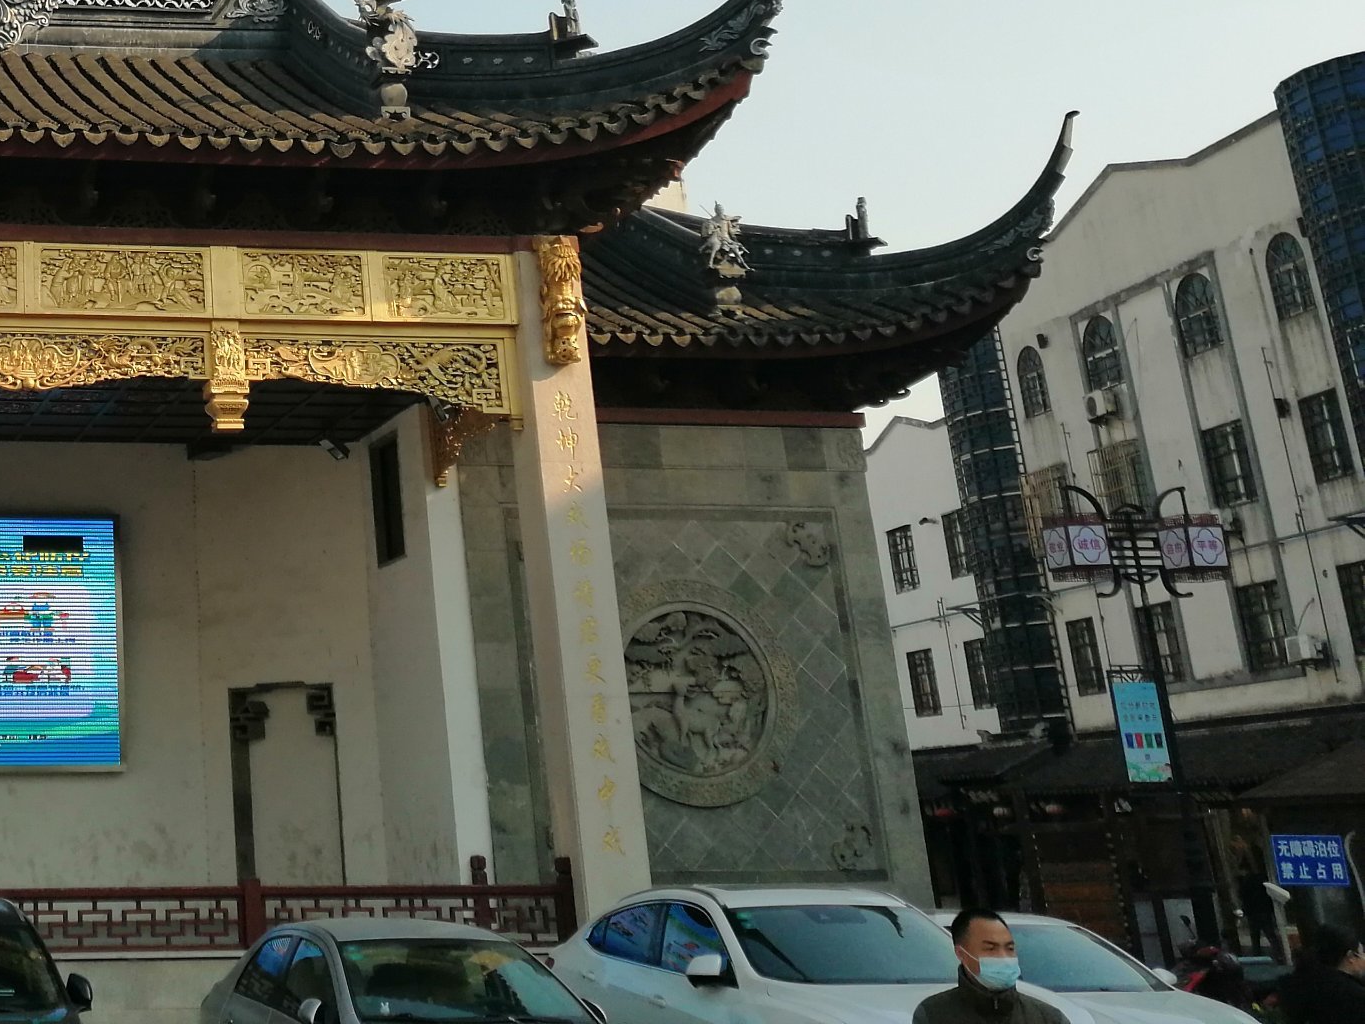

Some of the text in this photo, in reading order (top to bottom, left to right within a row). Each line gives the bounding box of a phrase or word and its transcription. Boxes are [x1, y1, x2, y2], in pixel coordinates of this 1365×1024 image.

[1077, 538, 1102, 551] 诚信
[1196, 539, 1219, 551] 平等
[1277, 839, 1341, 858] 无障碍泊位
[1280, 861, 1344, 880] 禁止占用
